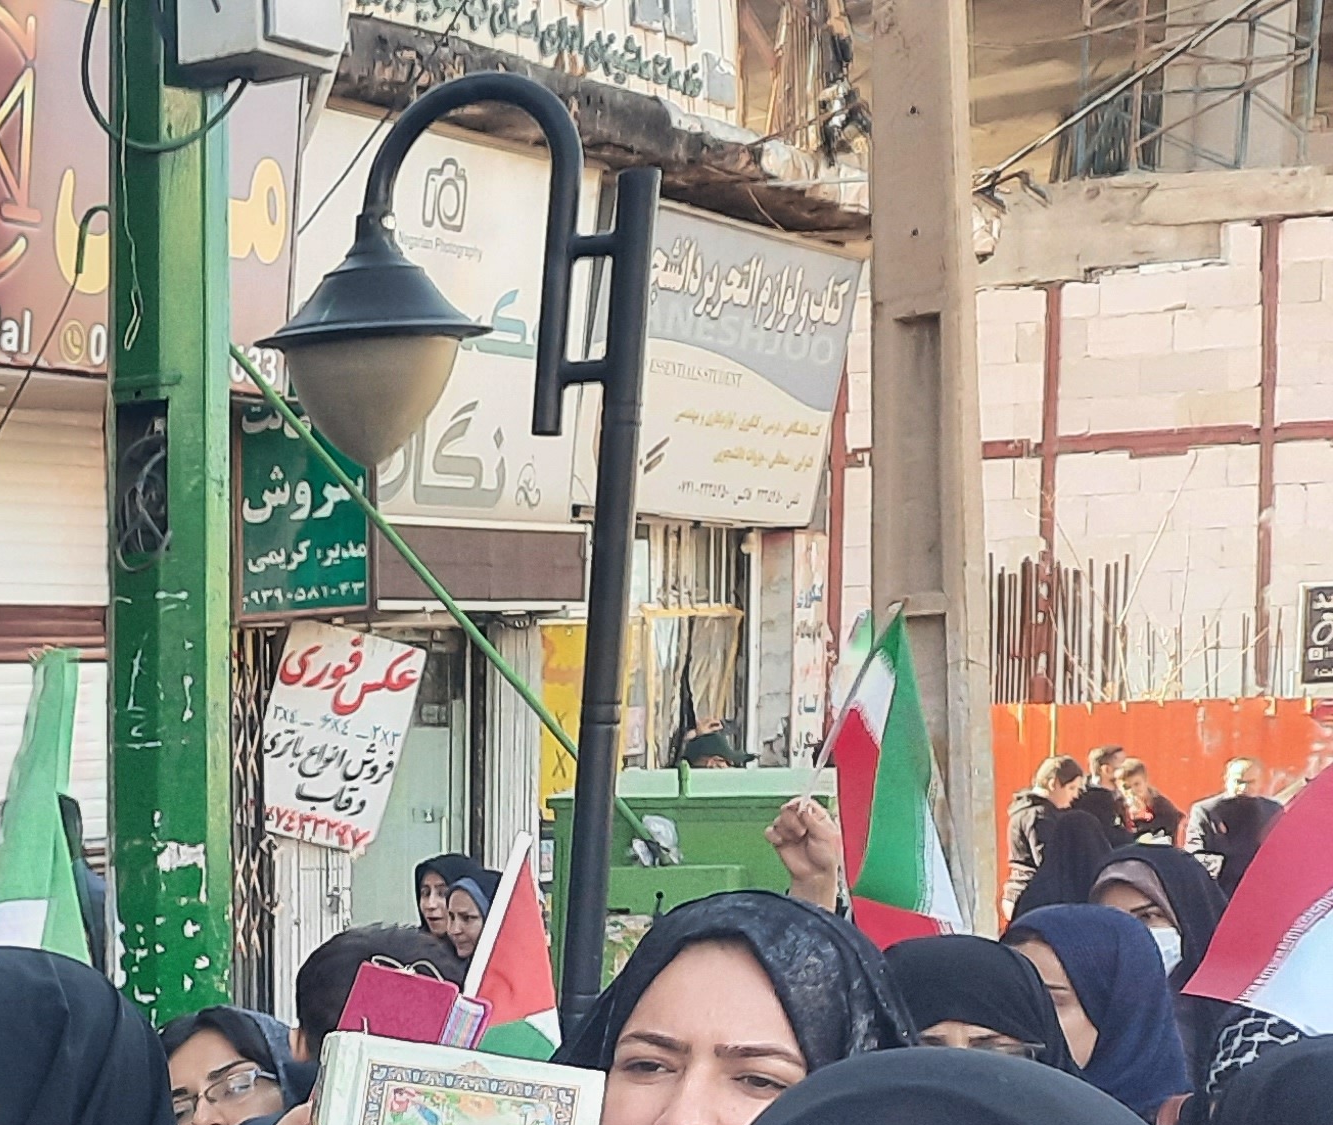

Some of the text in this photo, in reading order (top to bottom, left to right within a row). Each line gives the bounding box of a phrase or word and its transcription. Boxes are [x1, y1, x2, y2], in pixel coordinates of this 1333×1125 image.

[651, 237, 702, 304] دانشج
[810, 275, 852, 335] کتاب
[242, 465, 364, 524] سروش
[247, 539, 311, 574] کریمی
[279, 636, 419, 716] عکس فوری
[298, 743, 348, 779] انواع
[341, 742, 395, 785] فروش
